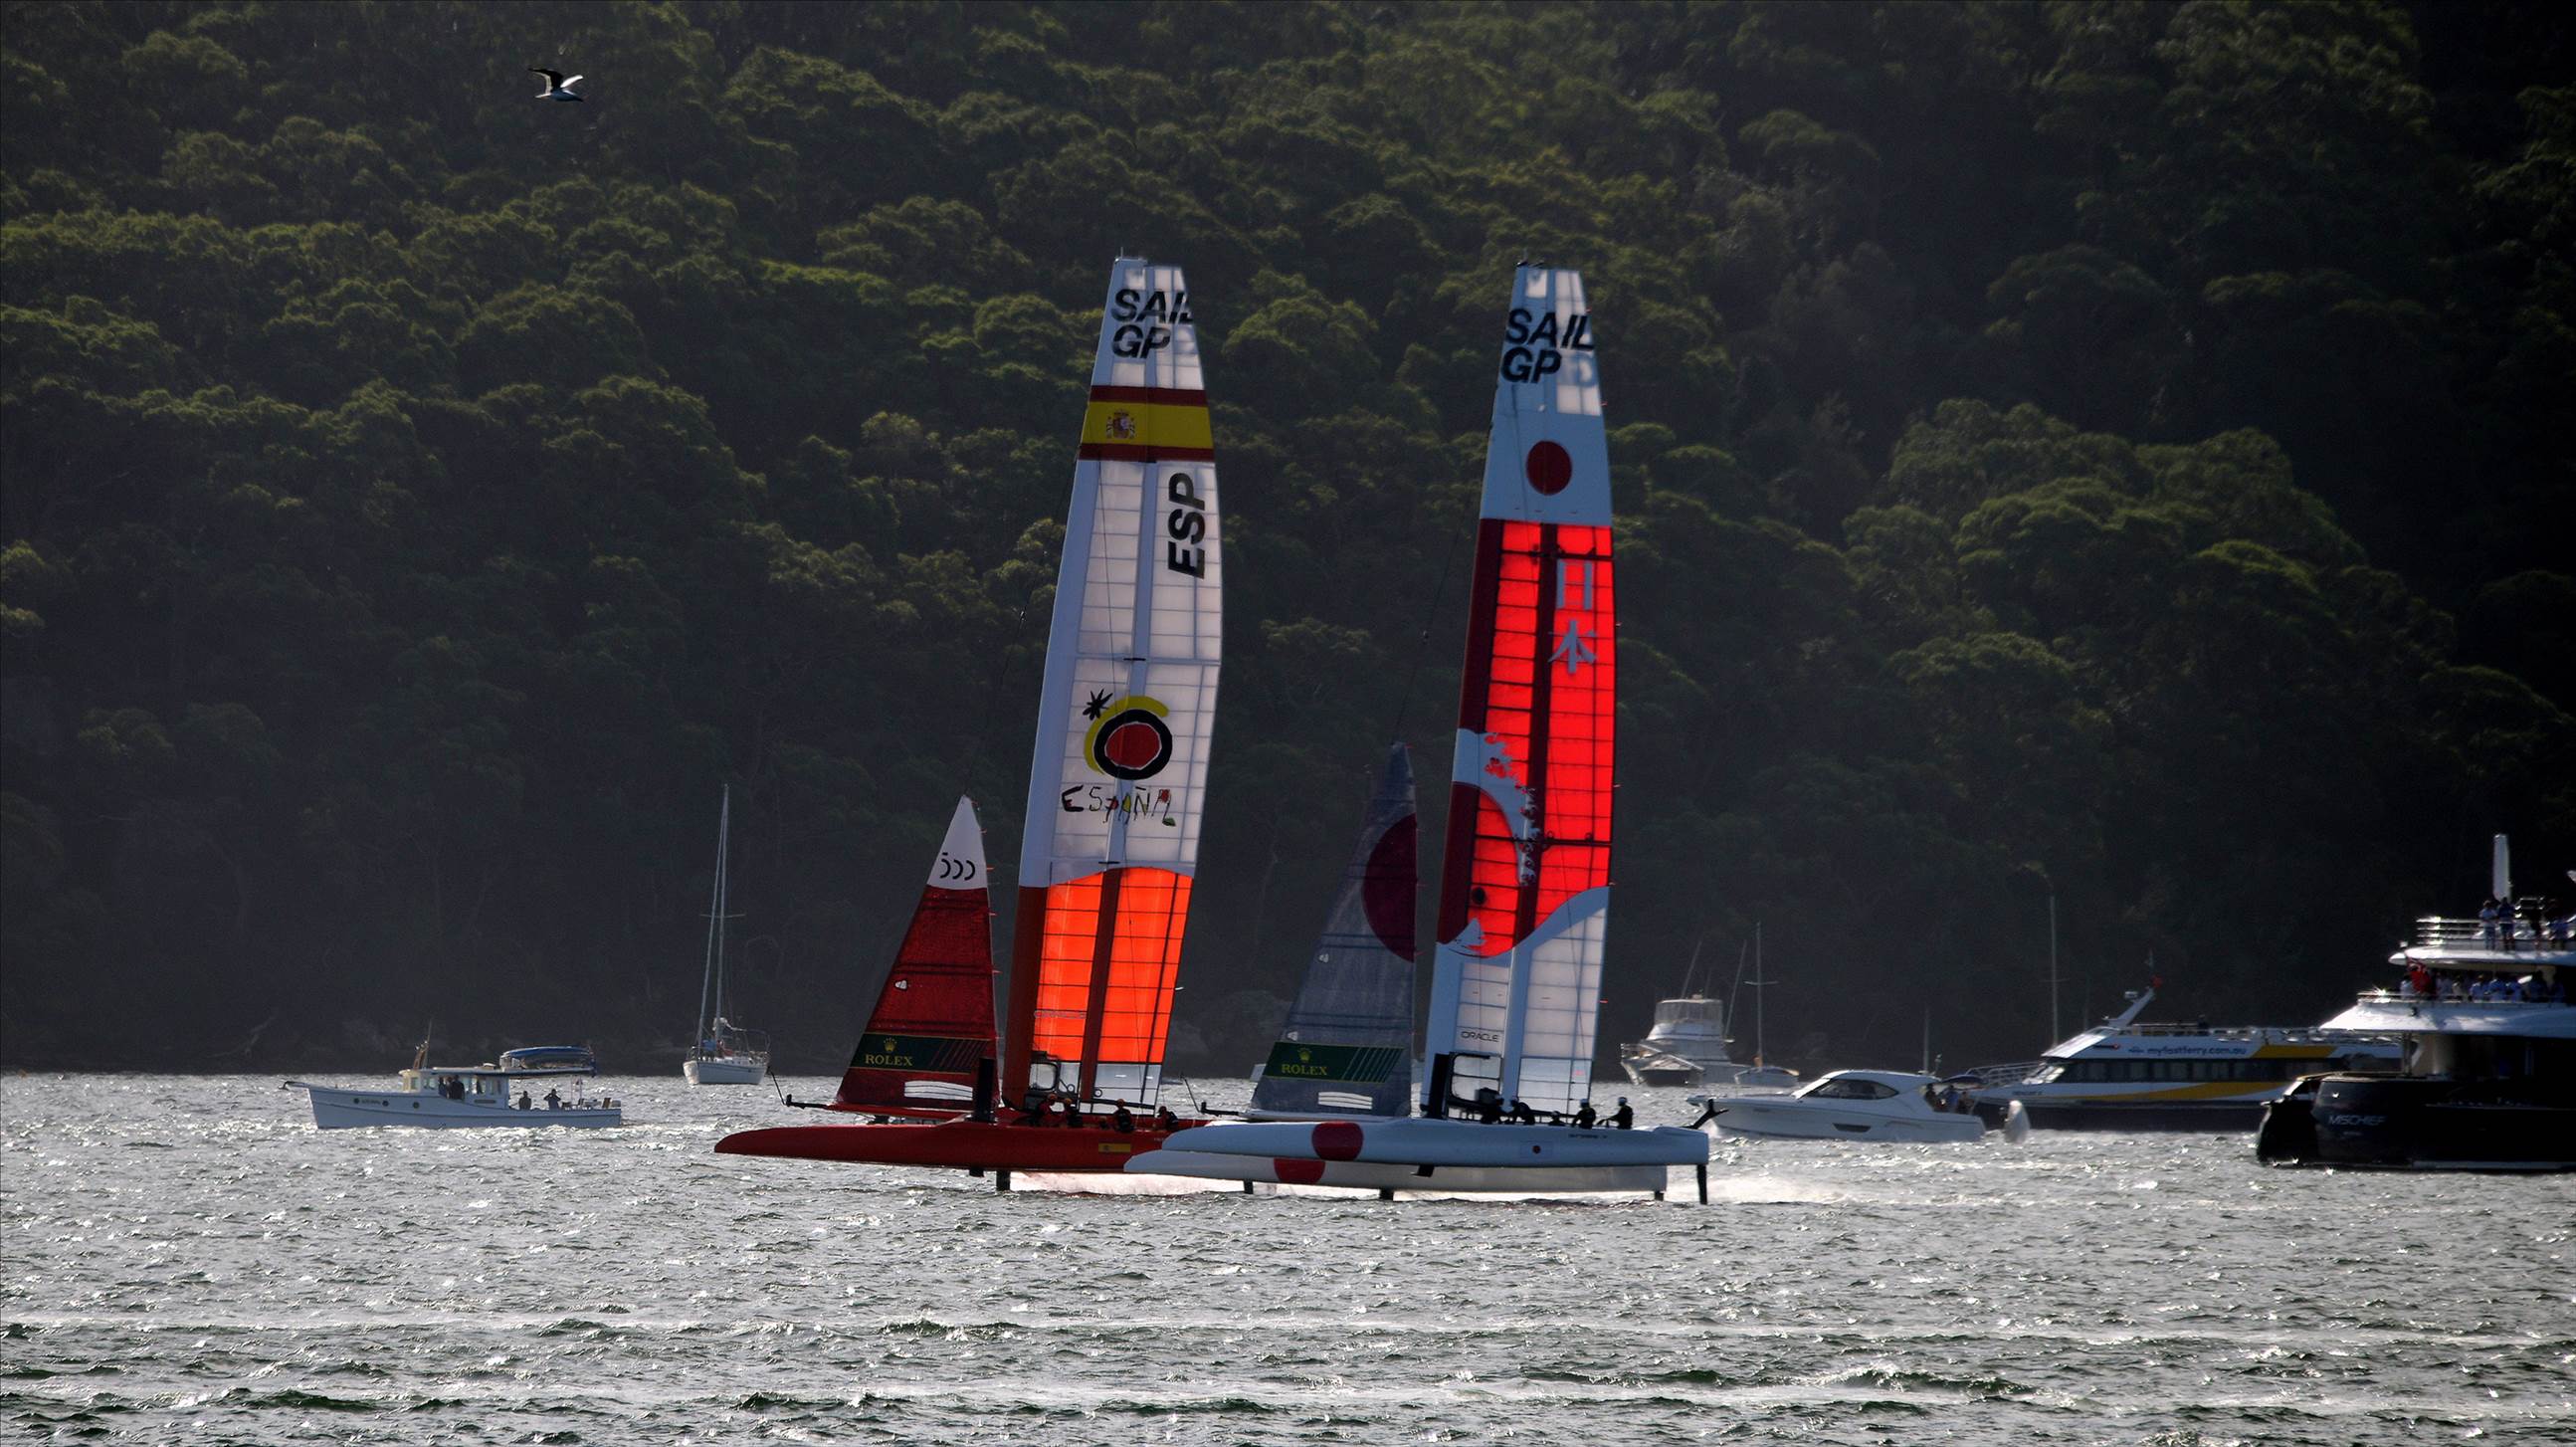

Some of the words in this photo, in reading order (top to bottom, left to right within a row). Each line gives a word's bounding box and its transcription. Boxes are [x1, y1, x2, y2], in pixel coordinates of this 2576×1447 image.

[1110, 289, 1193, 323] SAIL
[1111, 324, 1171, 358] GP
[1505, 309, 1594, 350] SAIL
[1500, 346, 1562, 384] GP
[1168, 473, 1206, 579] ESP
[1061, 785, 1176, 827] ESPAÑA
[1461, 1031, 1500, 1043] ORACLE
[865, 1054, 913, 1067] ROLEX
[1281, 1064, 1328, 1076] ROLEX
[2328, 1115, 2387, 1127] MISCHIEF
